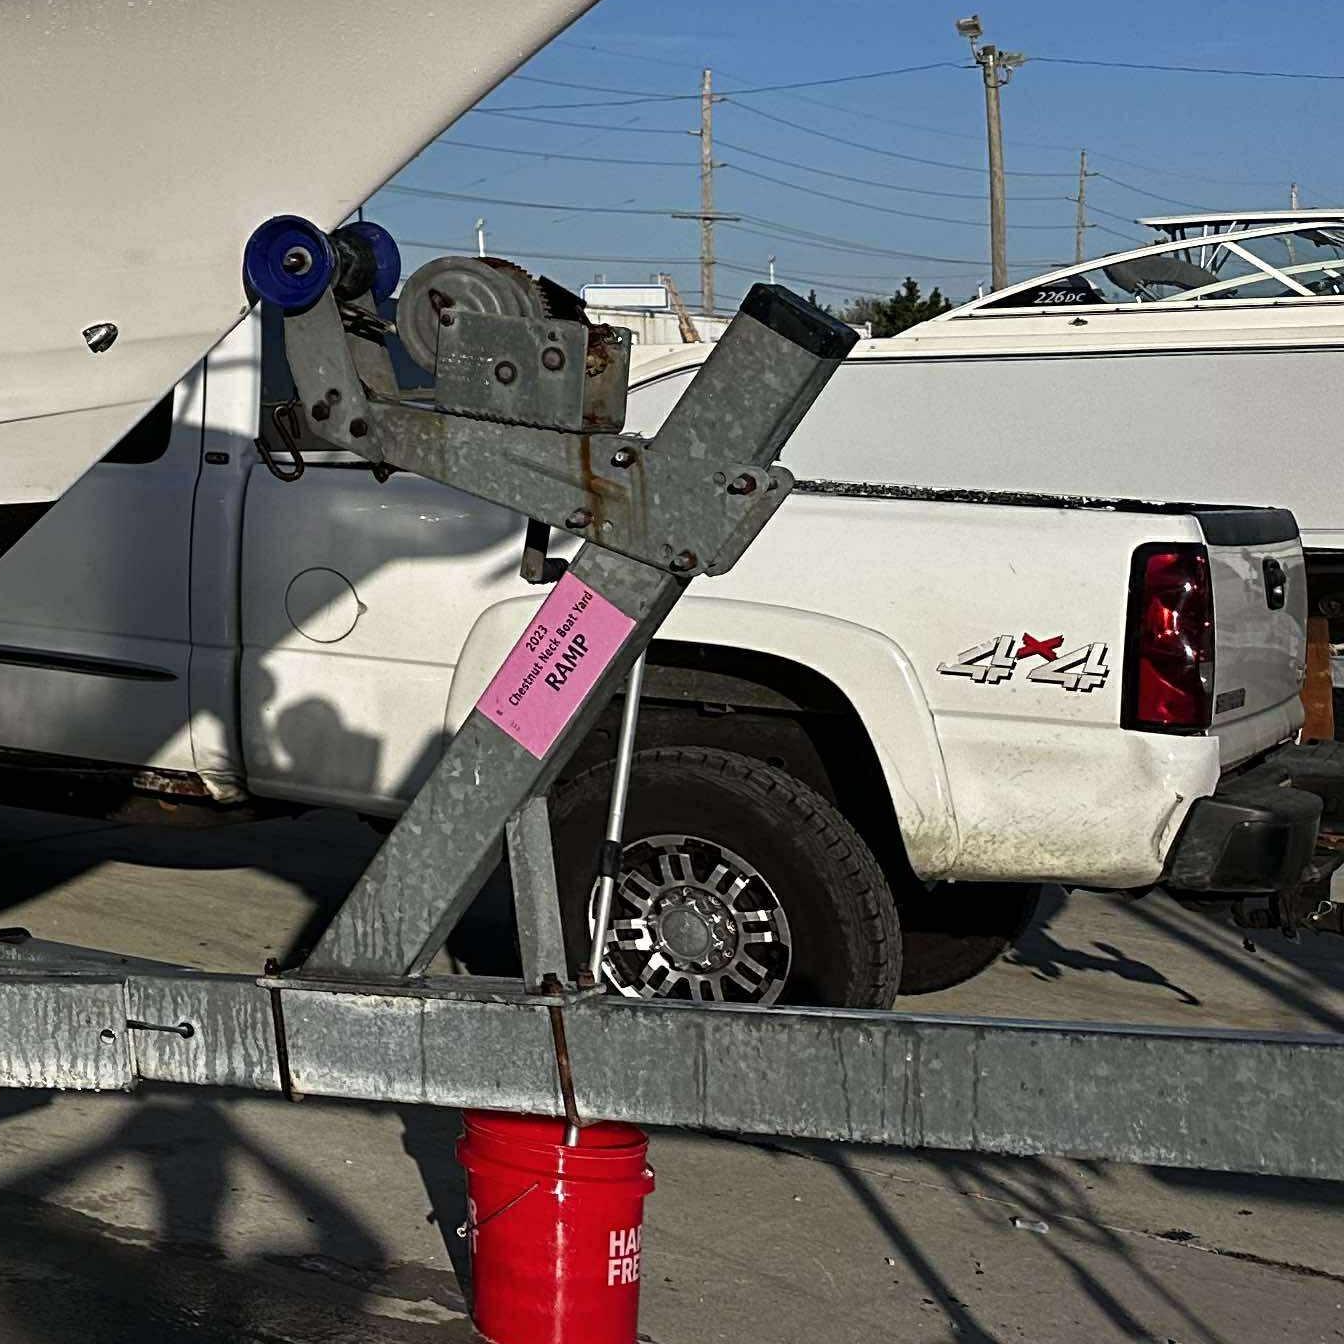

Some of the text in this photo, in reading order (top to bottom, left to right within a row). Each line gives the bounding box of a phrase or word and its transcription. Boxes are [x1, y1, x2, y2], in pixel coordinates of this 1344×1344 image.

[508, 590, 593, 707] Chestnut Neck Boat Yard
[525, 624, 548, 653] 2023
[544, 633, 589, 692] RAMP
